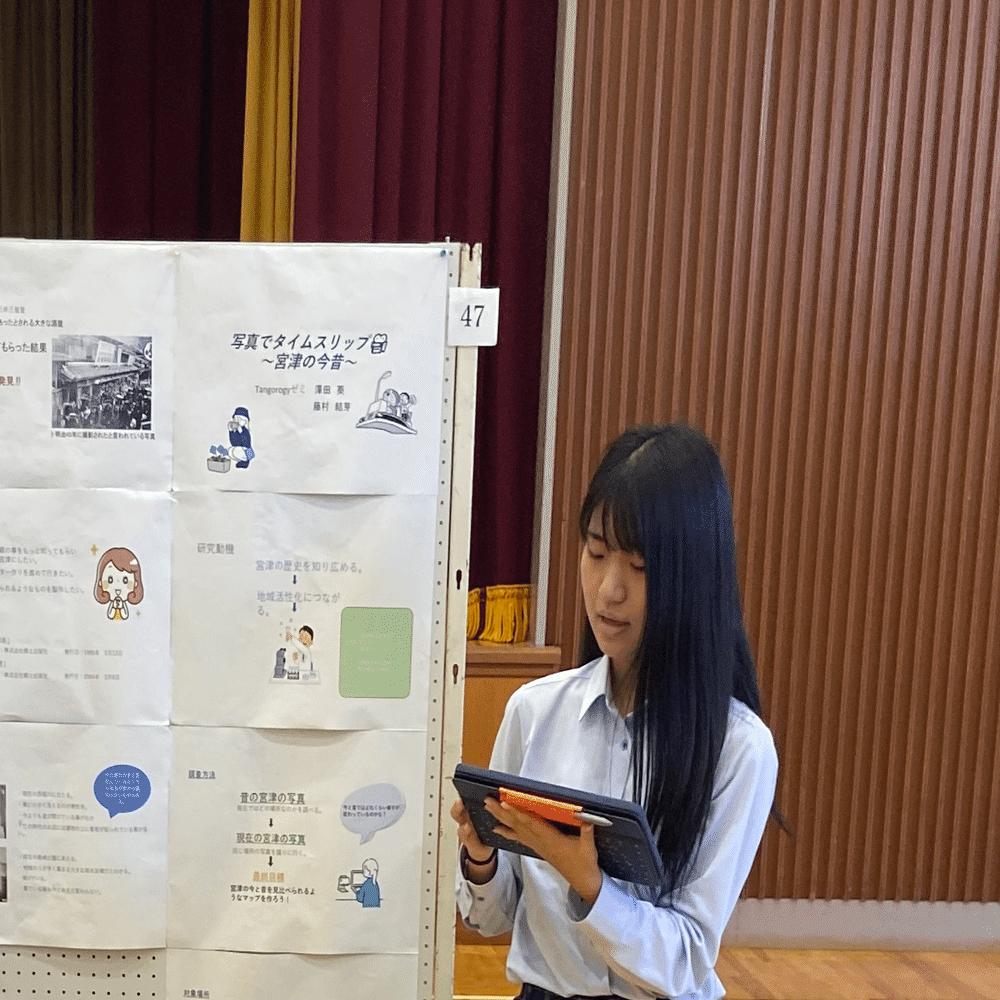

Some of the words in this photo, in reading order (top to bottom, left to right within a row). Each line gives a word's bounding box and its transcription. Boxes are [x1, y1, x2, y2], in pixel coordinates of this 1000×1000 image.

[460, 305, 484, 328] 47
[230, 333, 371, 351] 写真でタイムスリップ
[313, 401, 329, 412] 藤村
[197, 543, 234, 555] 研究動機
[255, 560, 363, 574] 宮津の歴史を知り広める。
[257, 591, 340, 603] 地域活性化につなが
[257, 605, 269, 617] る。
[188, 770, 216, 780] 調査方法
[239, 792, 305, 805] 昔の宮津の写真
[236, 833, 306, 846] 現在の宮津の写真
[230, 885, 315, 896] 宮津の今と昔を見比べられるよ
